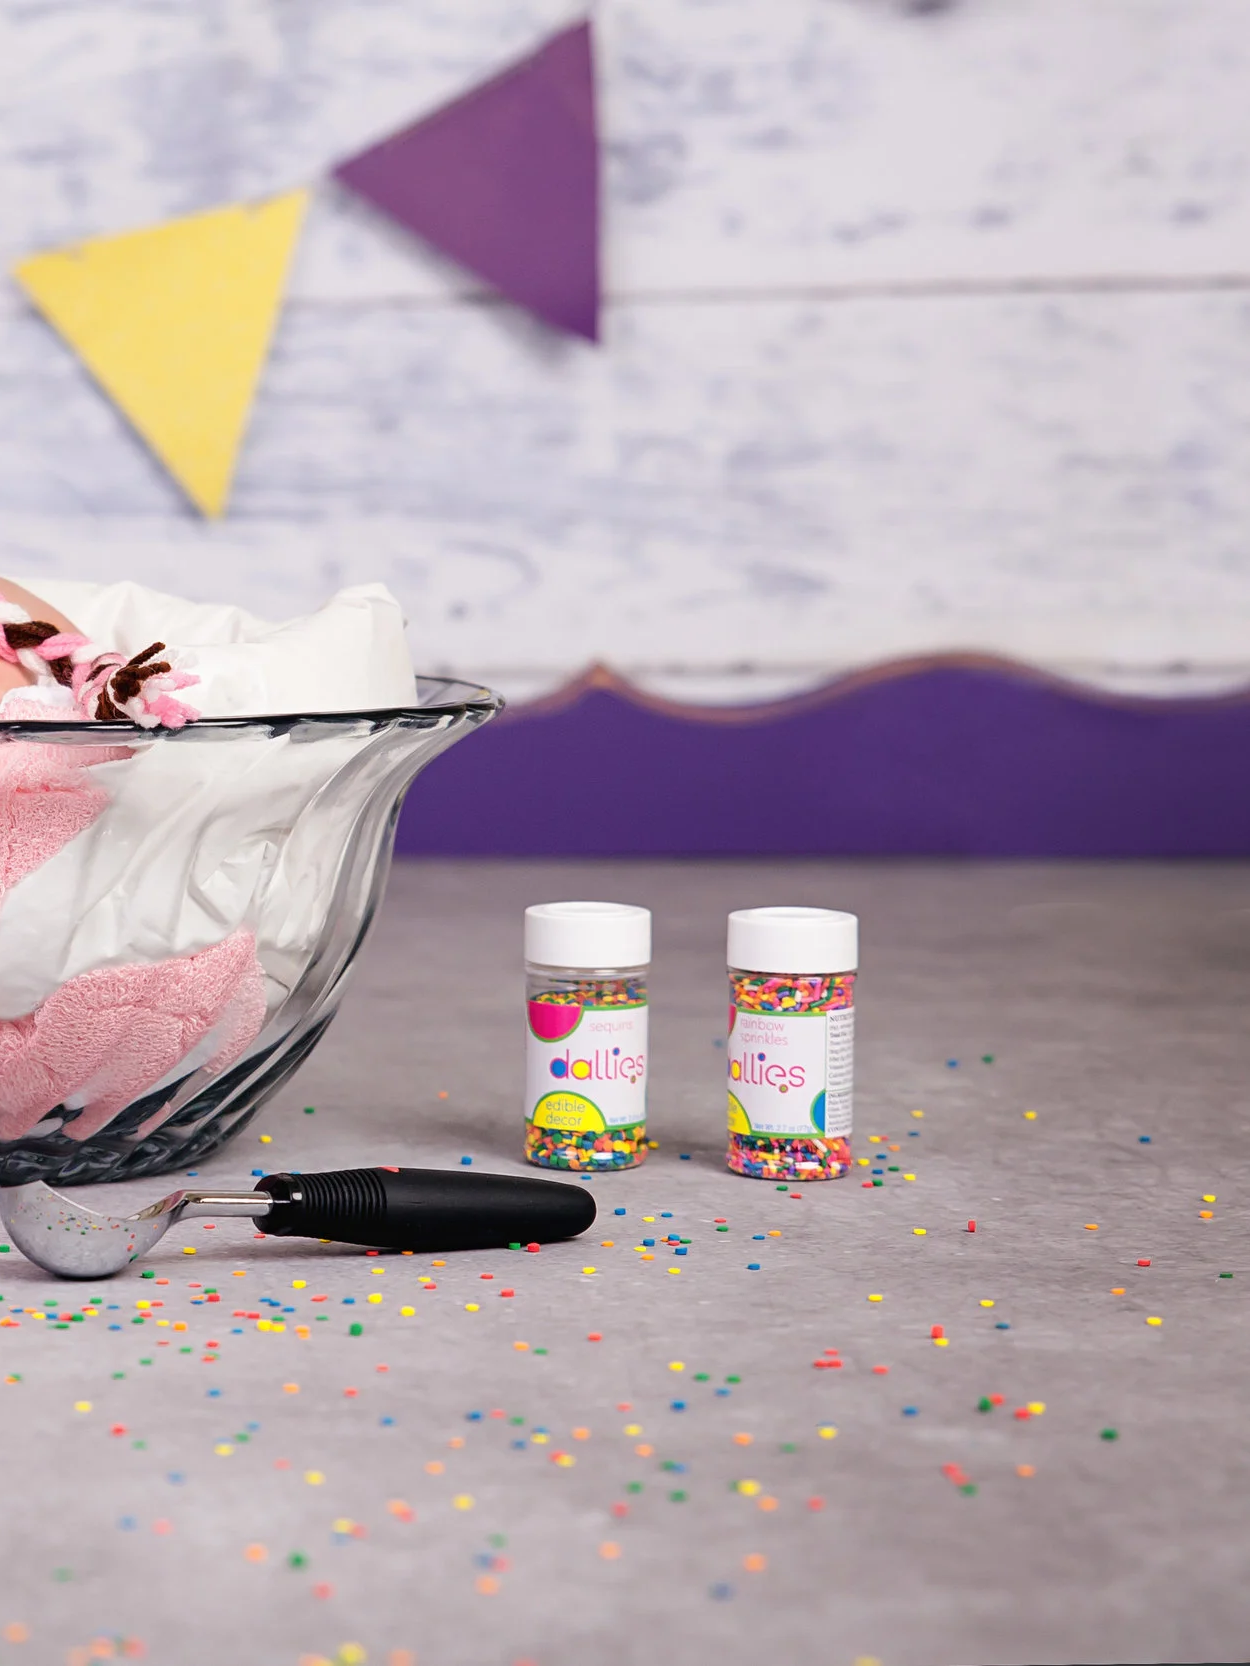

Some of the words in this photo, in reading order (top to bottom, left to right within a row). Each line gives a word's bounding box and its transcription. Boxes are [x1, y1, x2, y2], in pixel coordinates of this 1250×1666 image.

[740, 1018, 786, 1031] rainbow
[740, 1032, 789, 1046] sprinkles
[550, 1047, 645, 1084] dallies
[545, 1098, 586, 1113] edible
[545, 1112, 583, 1126] decor
